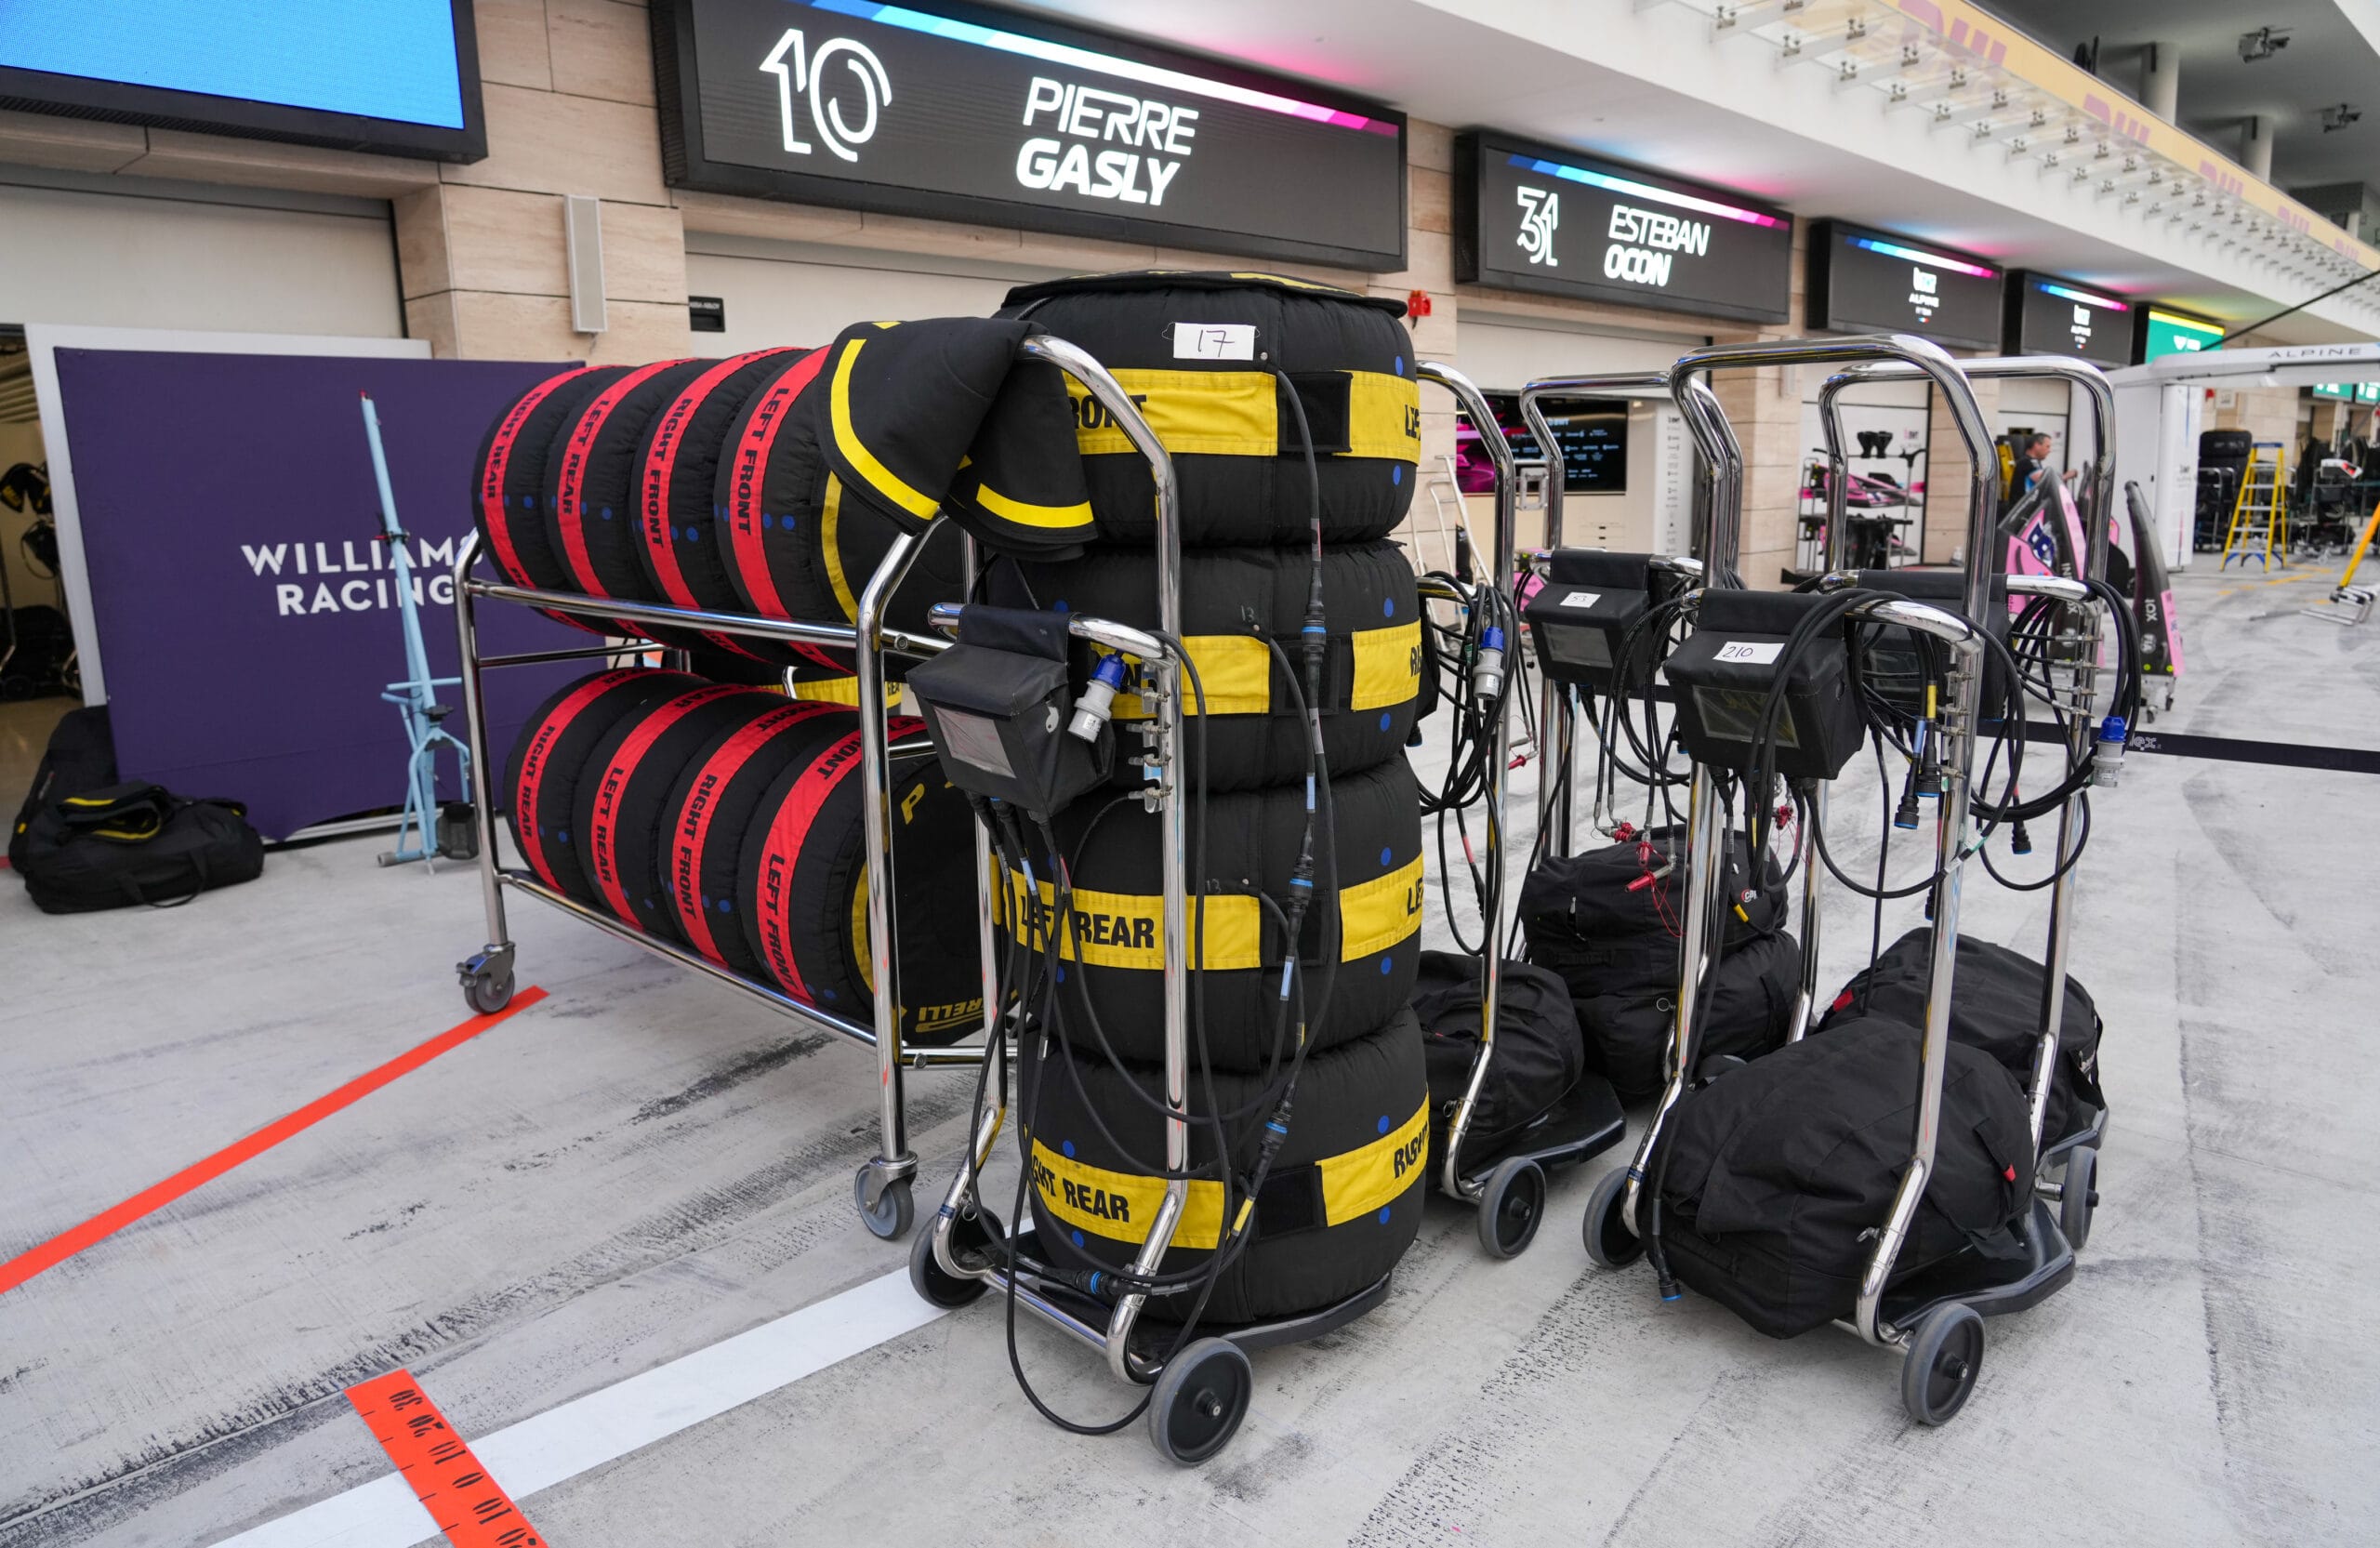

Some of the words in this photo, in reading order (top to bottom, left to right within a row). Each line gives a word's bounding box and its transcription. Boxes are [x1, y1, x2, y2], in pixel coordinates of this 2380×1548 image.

[759, 28, 892, 163] 10
[1023, 75, 1199, 156] PIERRE
[1016, 137, 1181, 206] GASLY
[1516, 186, 1560, 267] 31
[1608, 205, 1711, 257] ESTEBAN
[1604, 245, 1673, 287] OCON
[1197, 329, 1236, 358] 17
[2268, 347, 2361, 360] ALPINE
[502, 391, 543, 438] RIGHT
[576, 400, 611, 446] LEFT
[654, 399, 694, 461] RIGHT
[751, 388, 789, 442] LEFT
[487, 445, 506, 499] REAR
[562, 453, 580, 516] REAR
[737, 449, 758, 536] FRONT
[648, 470, 665, 549] FRONT
[276, 575, 454, 615] RACING
[1722, 645, 1754, 658] 210
[526, 725, 556, 781] RIGHT
[522, 786, 533, 839] REAR
[599, 767, 626, 820] LEFT
[683, 774, 718, 840] RIGHT
[596, 825, 612, 883] REAR
[678, 845, 697, 920] FRONT
[765, 853, 786, 916] LEFT
[765, 919, 800, 991] FRONT
[1075, 911, 1155, 949] REAR
[918, 998, 983, 1022] RELLI
[1063, 1177, 1130, 1224] REAR
